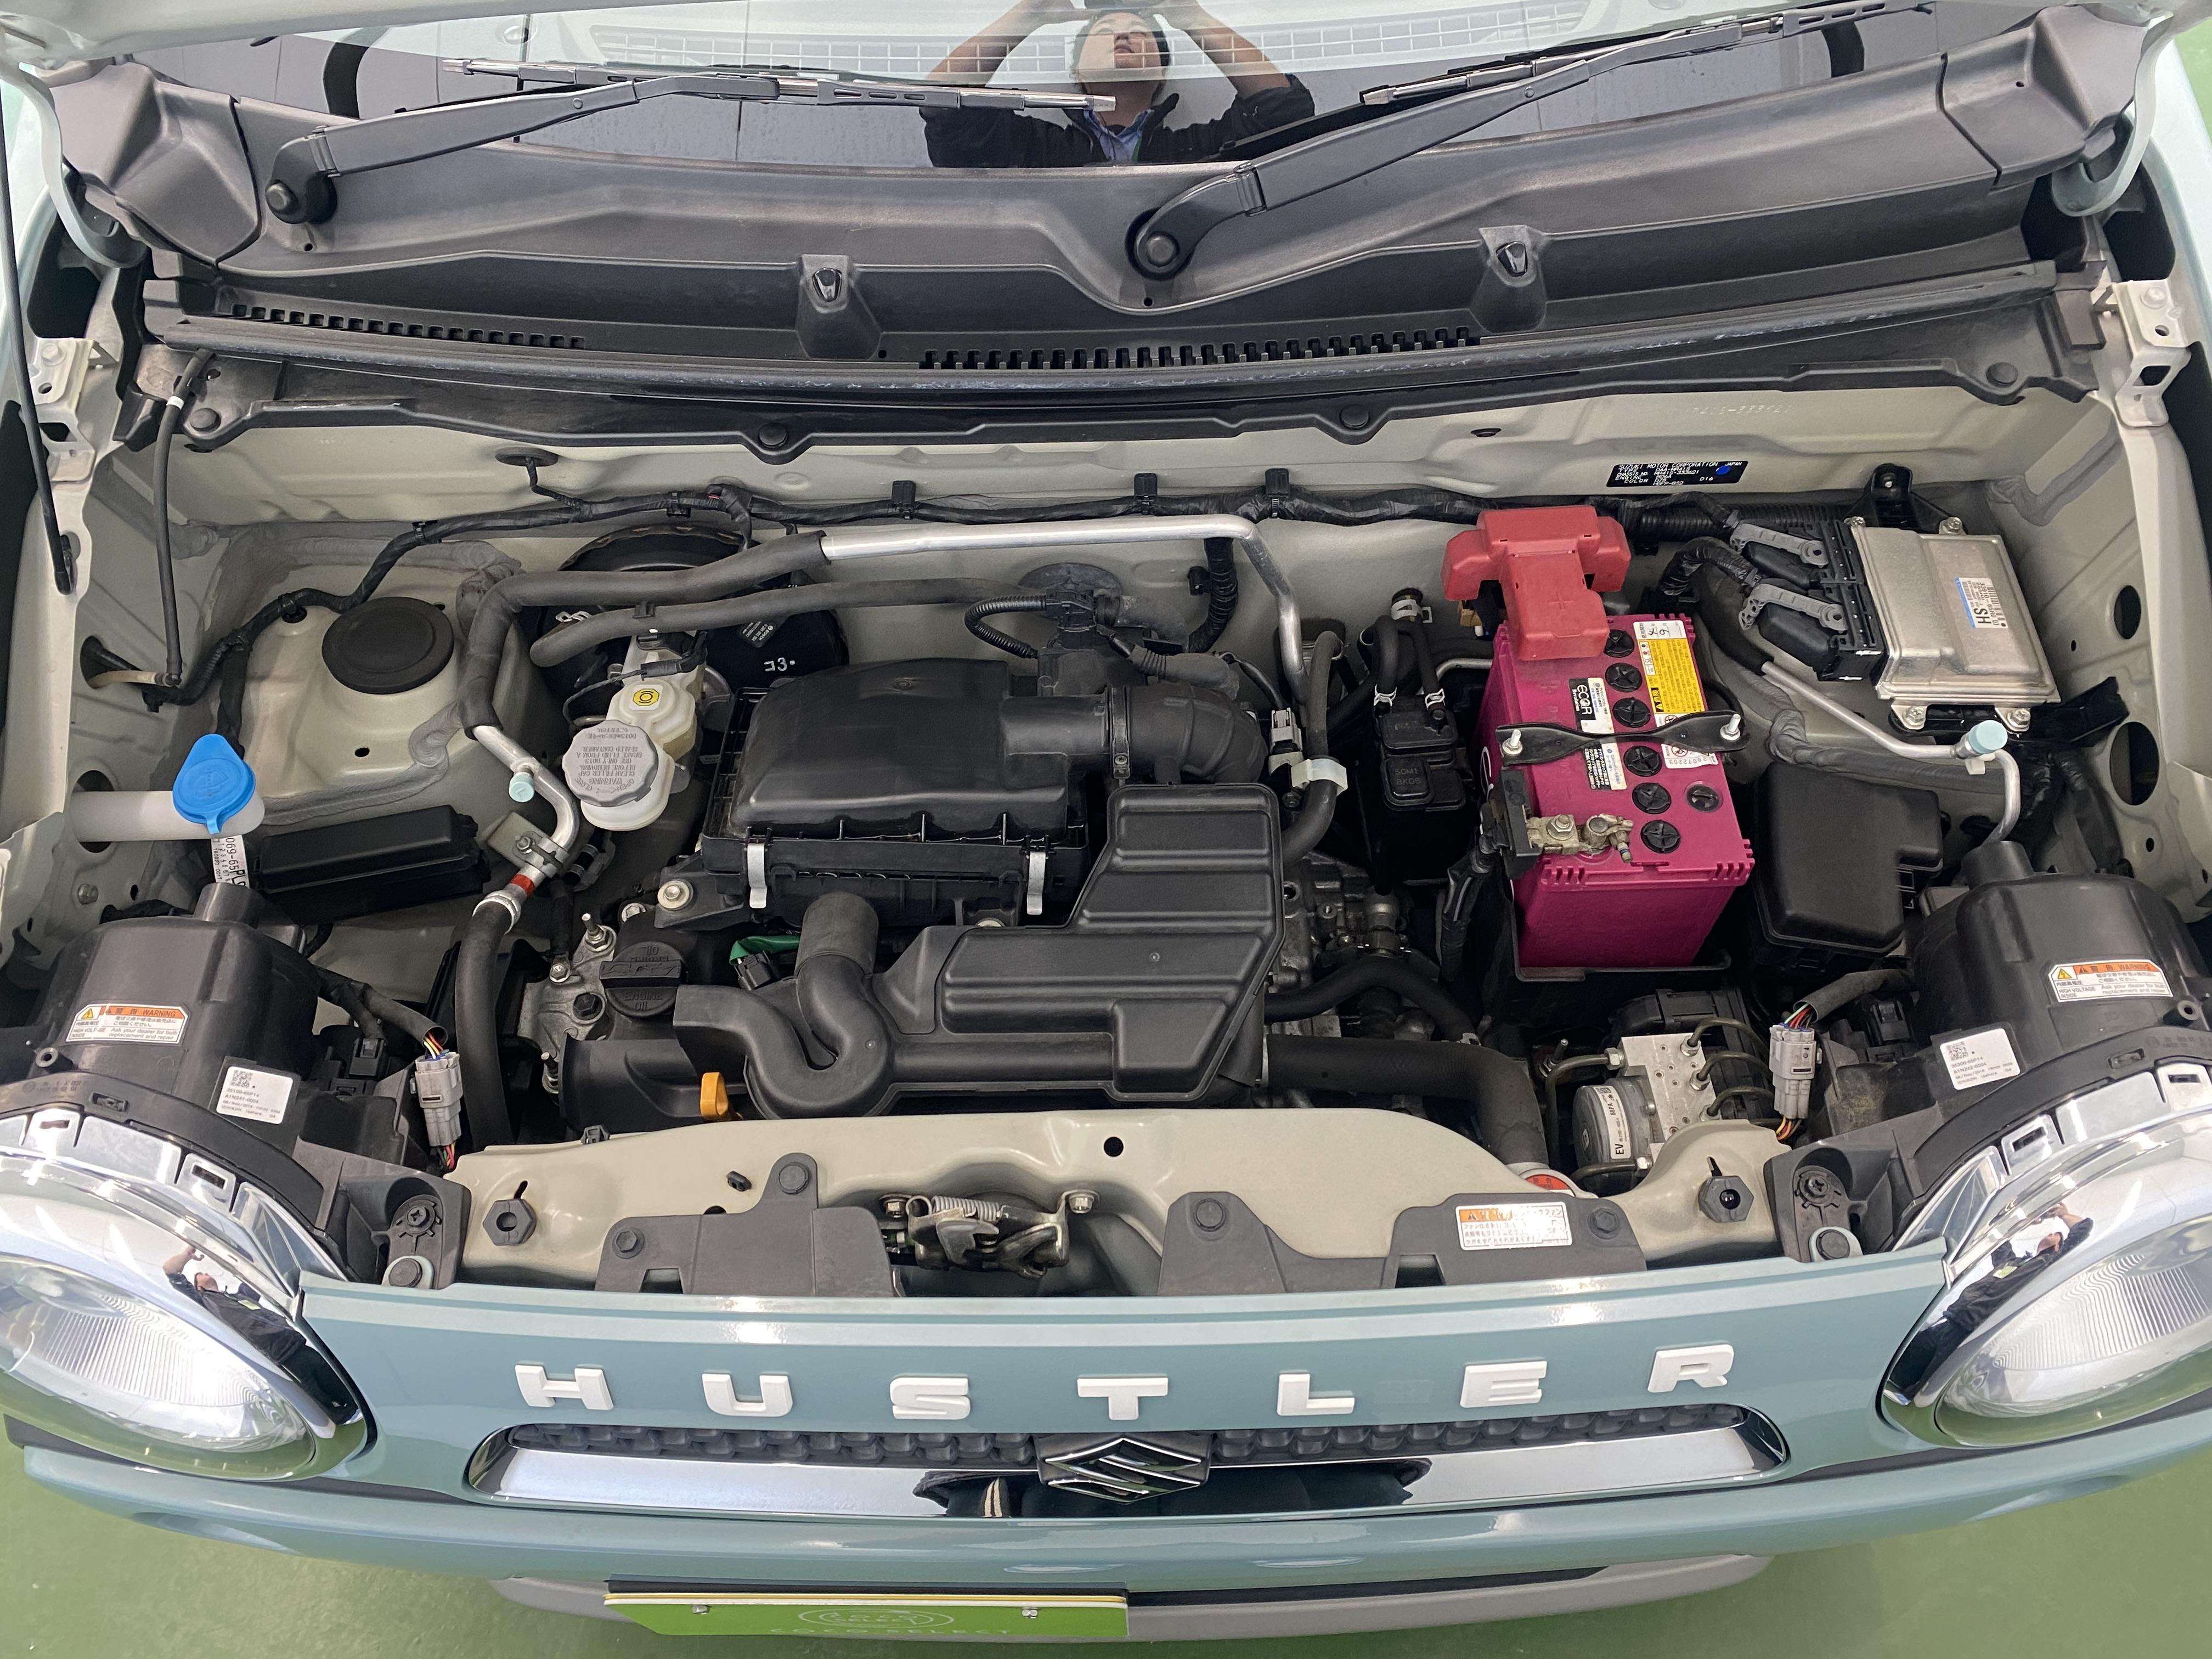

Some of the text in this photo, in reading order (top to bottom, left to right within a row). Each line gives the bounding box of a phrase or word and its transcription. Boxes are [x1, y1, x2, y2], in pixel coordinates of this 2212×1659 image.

[1973, 607, 1991, 624] SH
[142, 1009, 176, 1017] WARNING
[1615, 1143, 1624, 1154] EV
[515, 1343, 1735, 1421] HUSTLER
